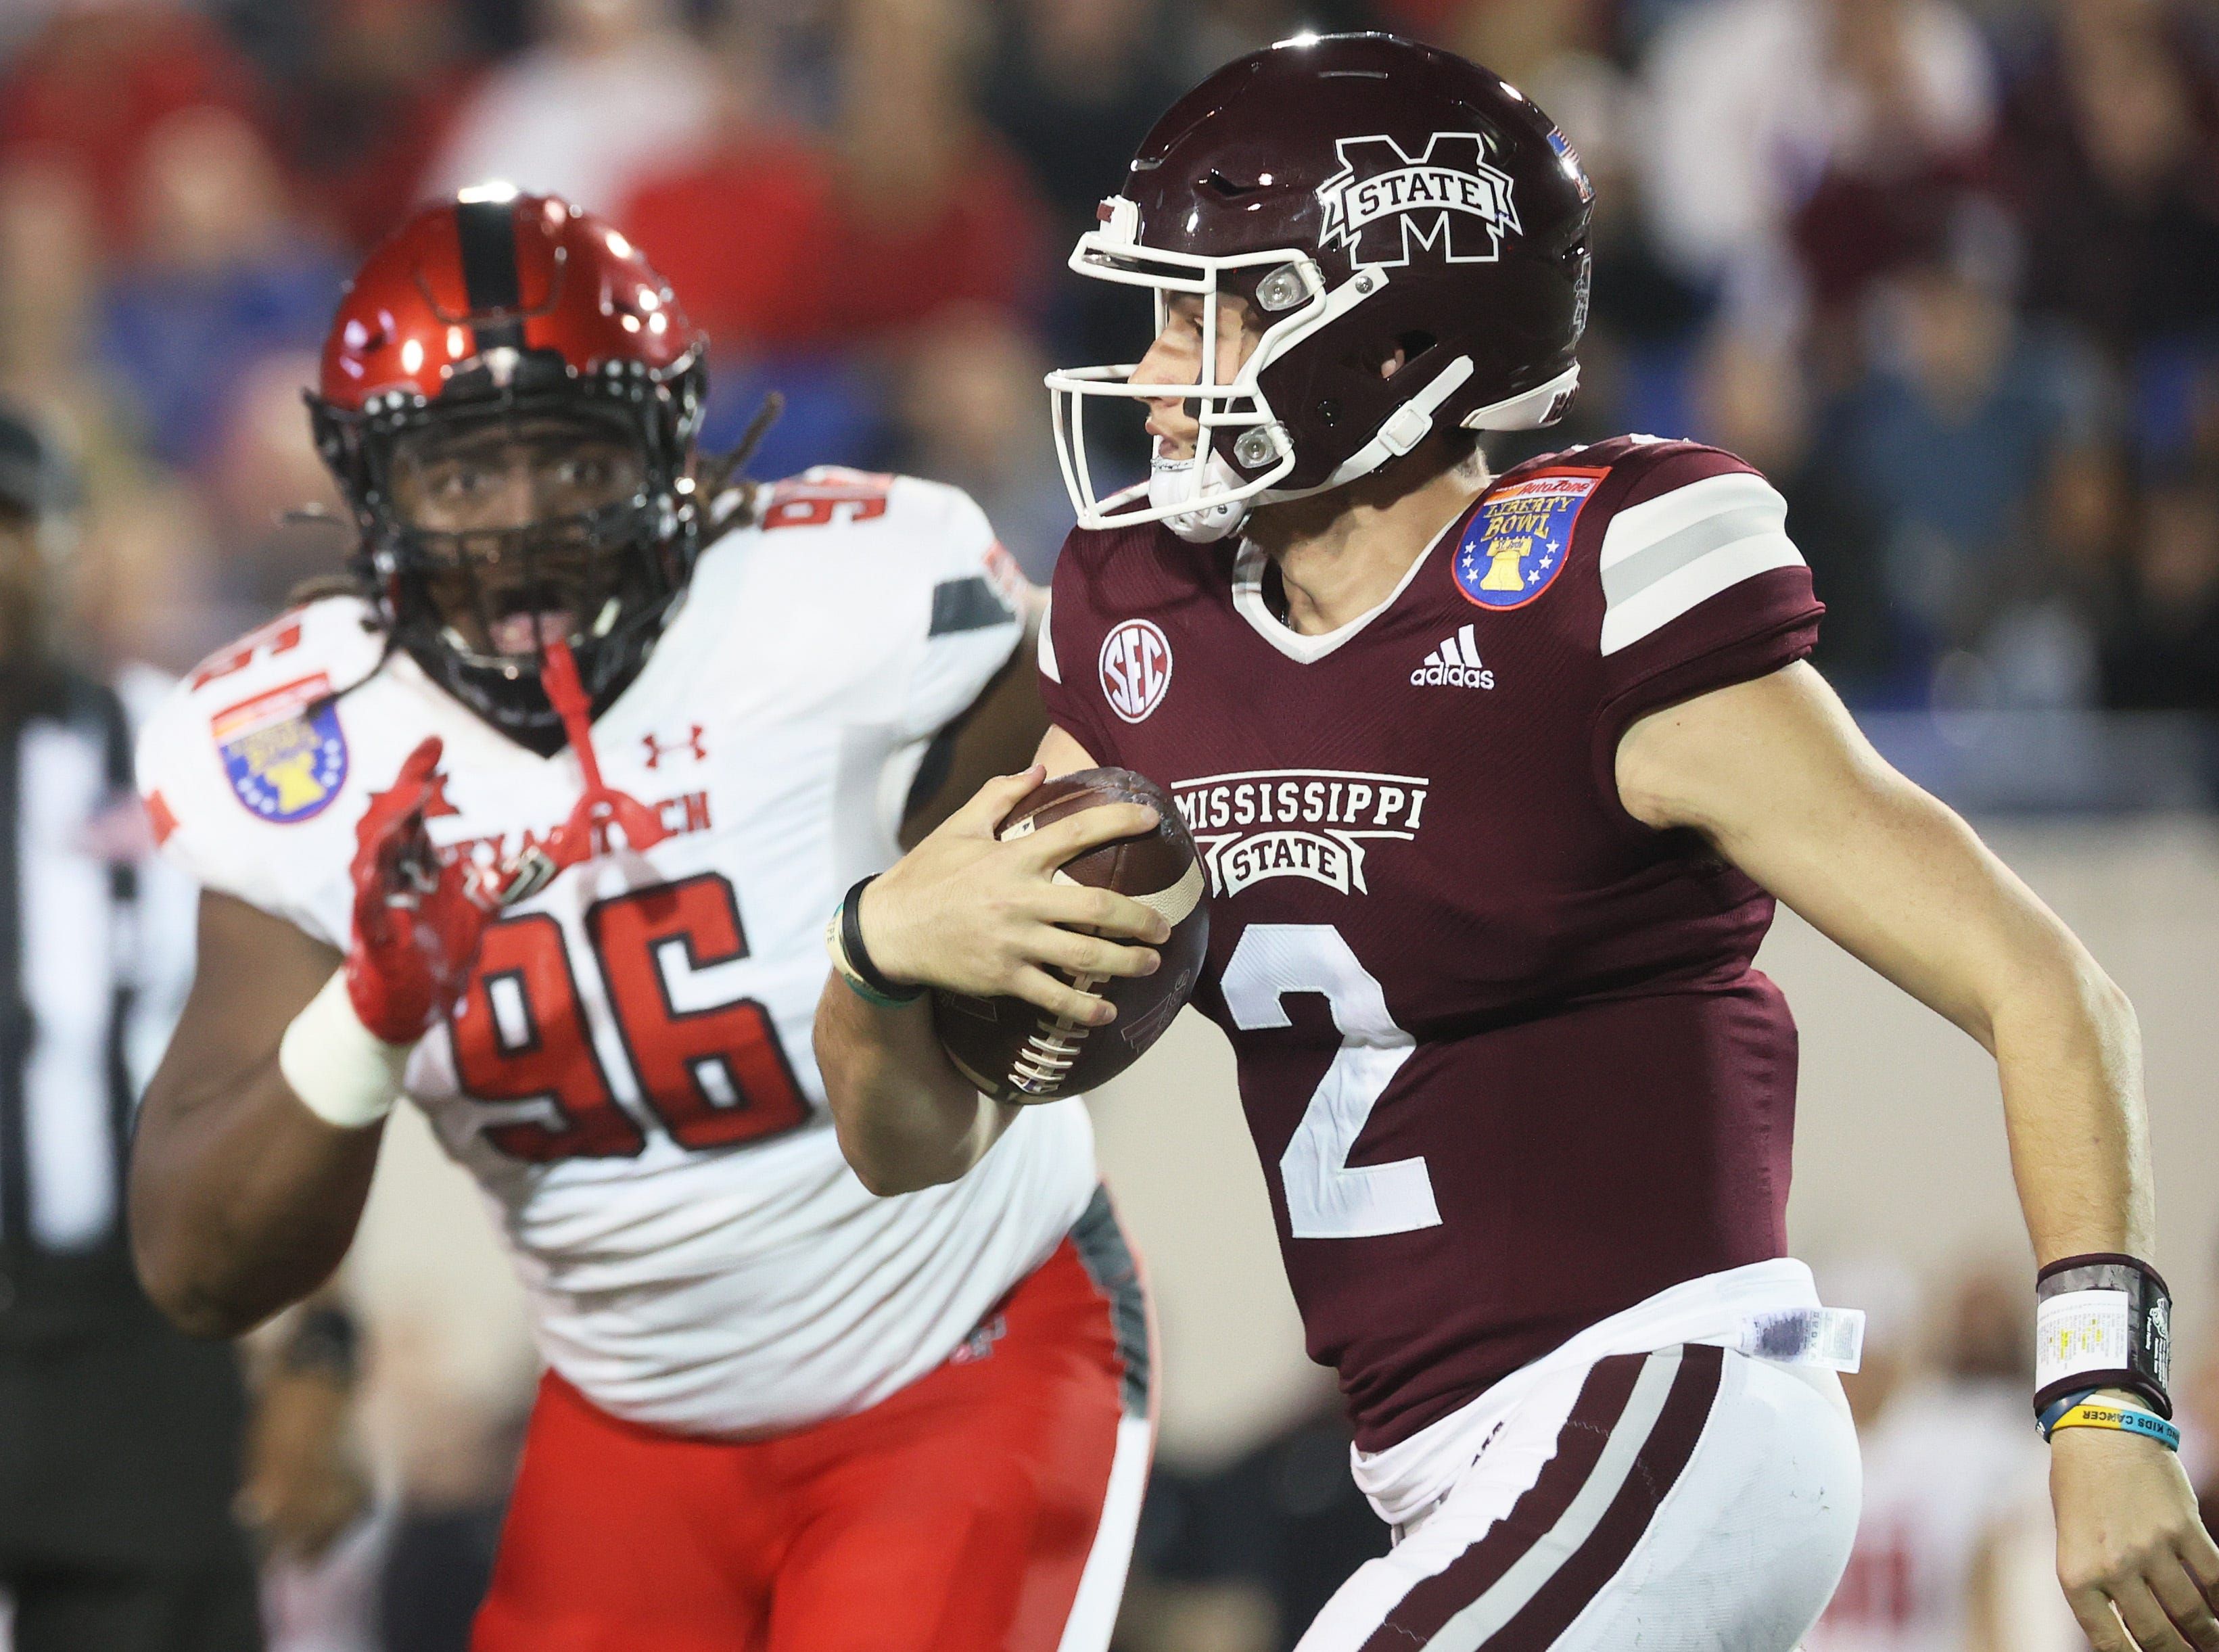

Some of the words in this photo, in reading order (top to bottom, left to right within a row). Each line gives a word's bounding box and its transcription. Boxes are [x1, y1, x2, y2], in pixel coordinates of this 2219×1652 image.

[1358, 173, 1482, 216] STATE
[1516, 480, 1589, 496] AutoZone
[1483, 496, 1575, 519] LIBERTY
[1480, 513, 1550, 542] BOWL
[1104, 628, 1163, 715] SEC
[1410, 661, 1495, 690] adidas
[1173, 782, 1427, 830] MISSISSIPPI
[1232, 838, 1337, 882] STATE
[446, 870, 816, 1160] 96
[1220, 924, 1444, 1239] 2
[2082, 1410, 2133, 1425] CANCER
[2138, 1418, 2164, 1434] KIDS
